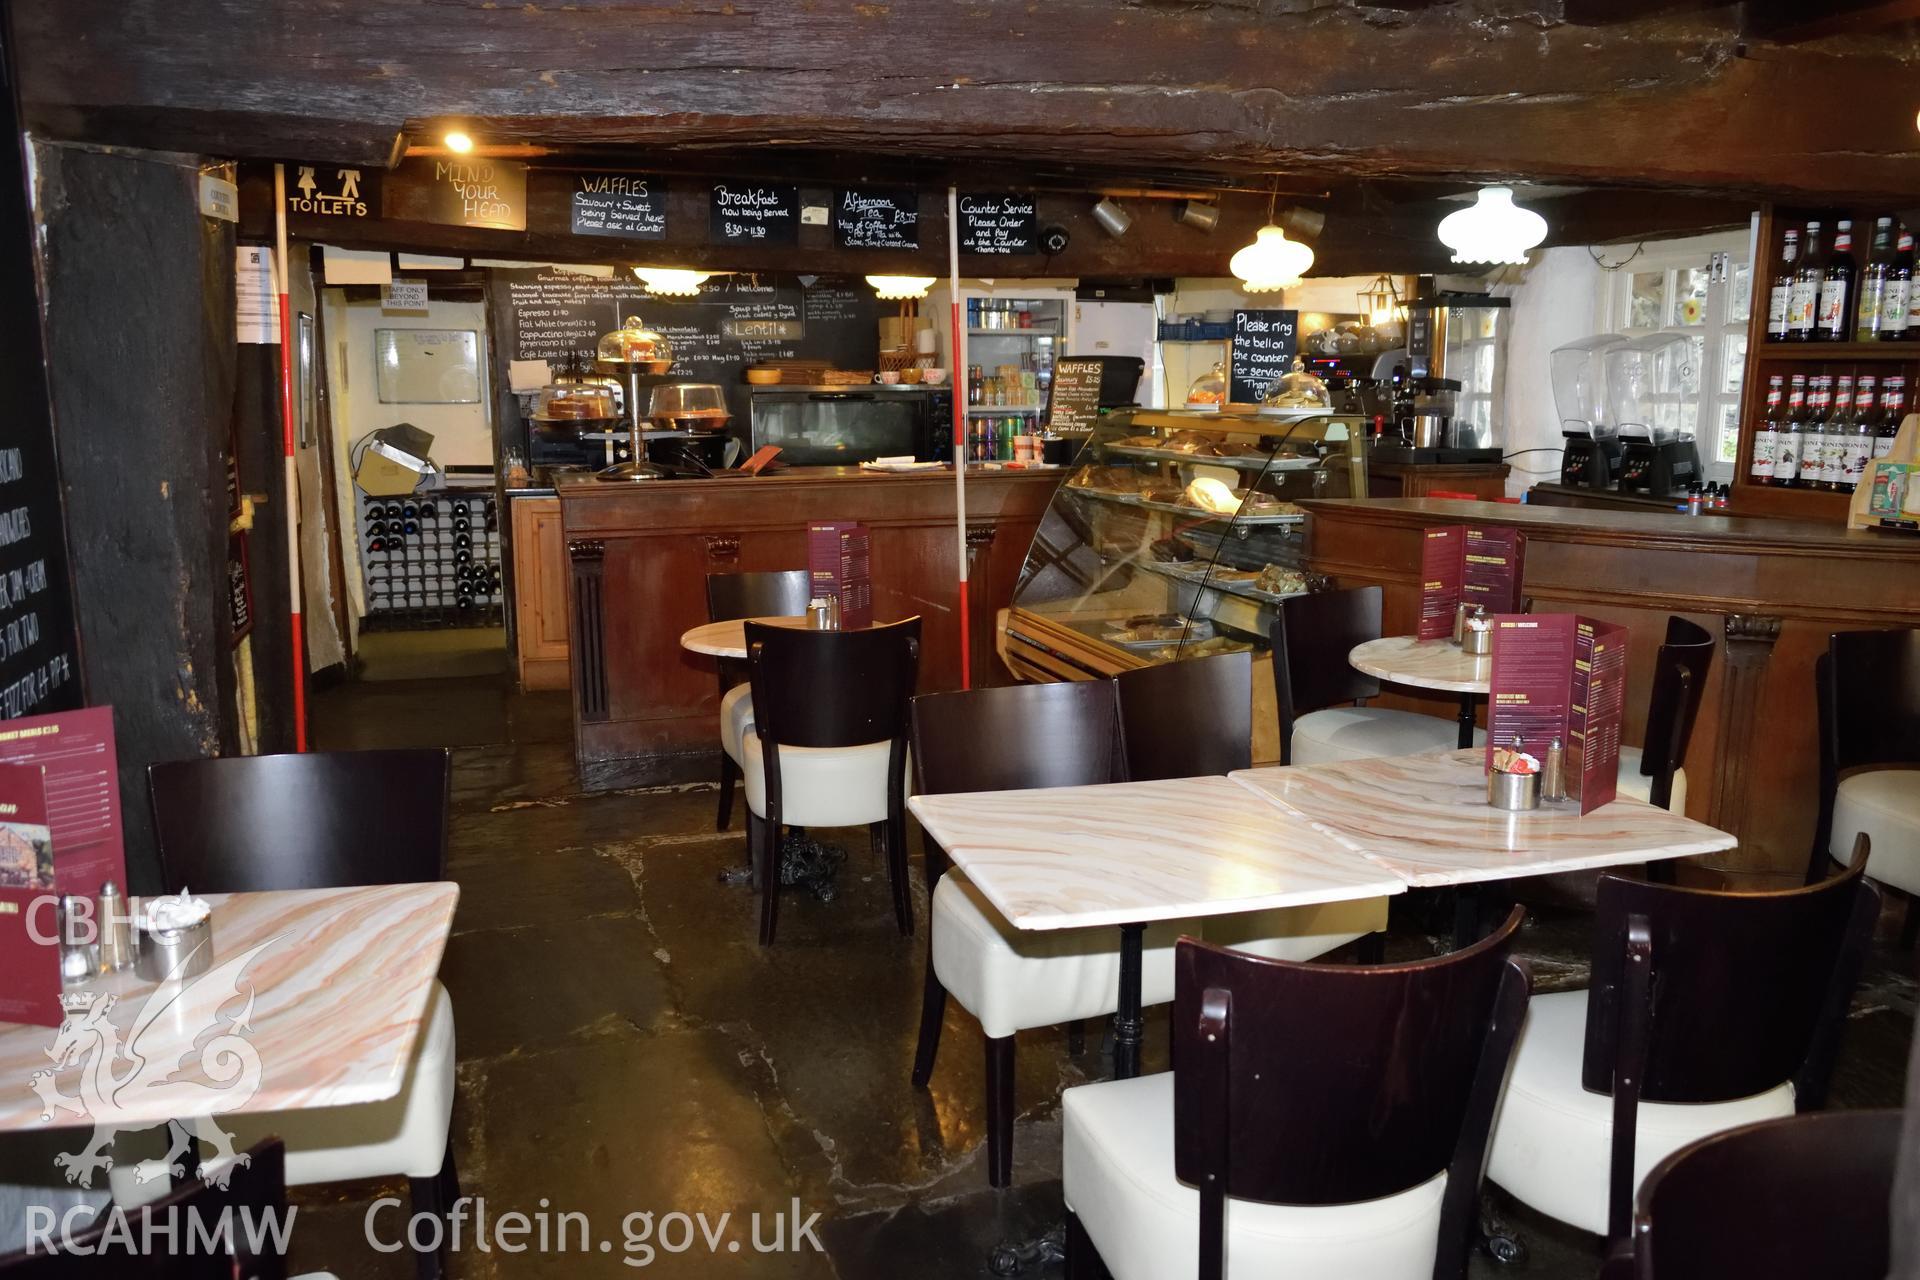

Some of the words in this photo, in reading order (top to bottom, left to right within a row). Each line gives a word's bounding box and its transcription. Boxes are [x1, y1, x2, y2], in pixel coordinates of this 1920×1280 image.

[436, 161, 494, 182] MIND
[454, 182, 500, 200] YOUR
[581, 176, 648, 197] WAFFLES
[714, 185, 778, 209] Breakfast
[843, 190, 896, 212] Afternoon
[289, 197, 367, 216] TOILETS
[464, 199, 511, 217] HEAD
[960, 196, 1000, 213] Counter
[1003, 198, 1033, 213] Service
[581, 208, 606, 221] being
[645, 213, 664, 223] here
[722, 208, 740, 216] now
[741, 208, 762, 220] being
[857, 206, 884, 218] Tea
[969, 215, 997, 227] Please
[999, 216, 1025, 227] Order
[976, 228, 991, 237] and
[995, 228, 1009, 240] Pay
[963, 237, 975, 245] at
[978, 238, 991, 246] the
[510, 283, 543, 291] Stunning
[736, 283, 774, 292] Welcome
[518, 308, 550, 319] Espresso
[729, 305, 751, 313] Soup
[519, 320, 533, 328] Flat
[735, 322, 777, 335] Lentil
[1236, 312, 1269, 332] Please
[1272, 322, 1293, 336] ring
[520, 330, 562, 340] Cappuccino
[520, 340, 560, 349] Americano
[1234, 334, 1250, 347] the
[1253, 336, 1271, 348] bell
[1272, 341, 1284, 349] on
[538, 350, 558, 358] Latte
[1233, 348, 1248, 360] the
[1251, 353, 1288, 362] counter
[1058, 363, 1101, 374] WAFFLES
[1233, 363, 1247, 374] for
[1250, 367, 1283, 377] service
